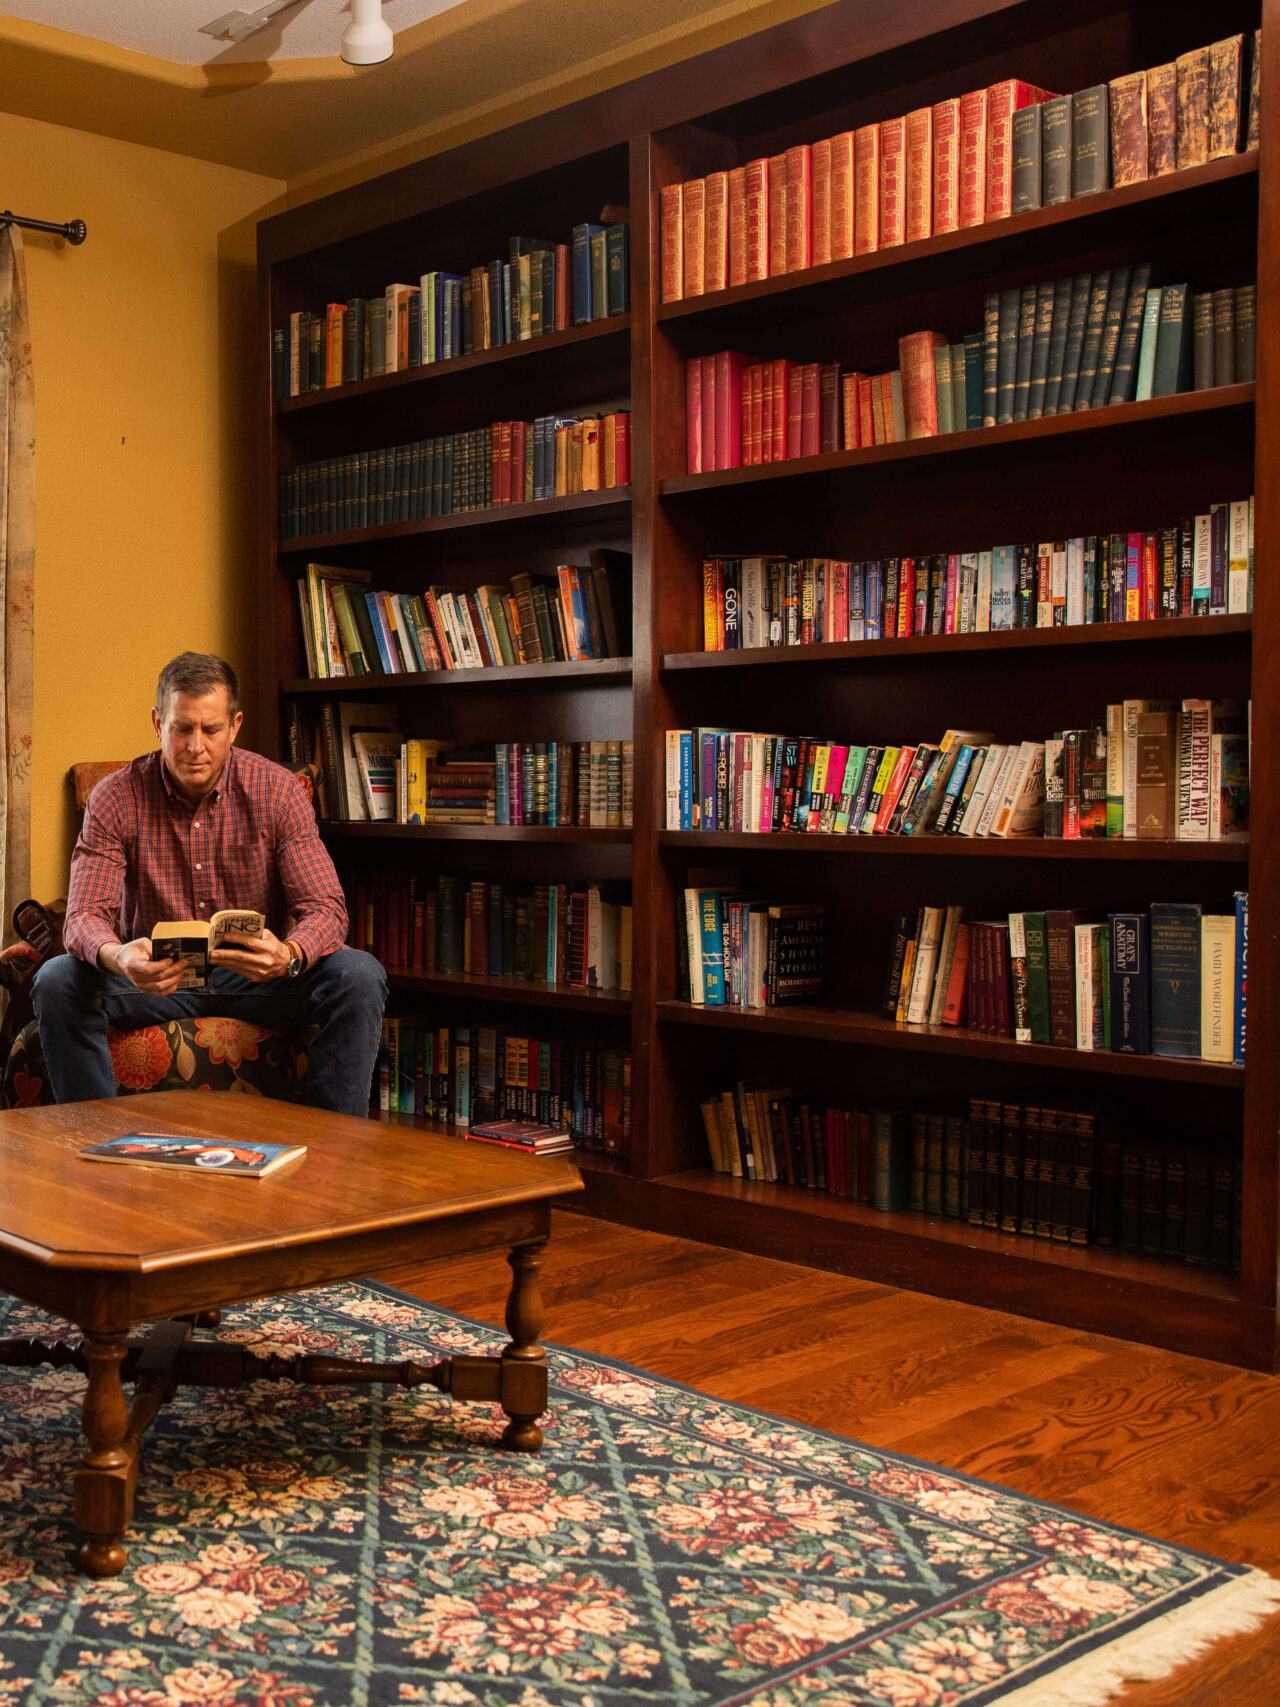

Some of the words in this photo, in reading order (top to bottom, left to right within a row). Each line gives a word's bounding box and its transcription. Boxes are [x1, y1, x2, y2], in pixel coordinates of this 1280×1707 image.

[1234, 517, 1246, 533] NORA
[1182, 531, 1192, 545] J.A.
[1198, 527, 1209, 557] SANDRA
[1233, 533, 1246, 556] ROBERTS
[1127, 546, 1139, 562] JANET
[1163, 540, 1176, 559] LINDA
[1182, 546, 1192, 569] JANCE
[1040, 557, 1048, 569] MARY
[1163, 559, 1176, 588] FAIRSTEIN
[1197, 559, 1208, 588] BROWN
[853, 575, 861, 591] VINCE
[948, 576, 956, 593] SUSAN
[802, 584, 813, 620] PATTERSON
[853, 592, 861, 608] FLYNN
[1040, 587, 1048, 602] CLARK
[1168, 588, 1176, 610] KILLER
[725, 588, 737, 631] GONE
[899, 588, 908, 632] DENIAL
[1127, 706, 1138, 720] KG
[1193, 709, 1209, 733] THE
[1127, 722, 1138, 738] 200
[1181, 709, 1193, 767] TECHNOWAR
[800, 740, 808, 765] STUART
[1109, 735, 1119, 769] LEAVING
[1180, 770, 1192, 780] IN
[1191, 736, 1211, 793] PERFECT
[717, 767, 727, 790] ROBB
[775, 765, 783, 789] WOODS
[797, 764, 805, 788] WOODS
[1047, 776, 1064, 787] Clan
[1109, 769, 1119, 794] HOME
[1047, 784, 1064, 795] Cave
[1047, 792, 1063, 800] Bear
[1083, 789, 1107, 801] WHISTLE
[1068, 805, 1079, 835] WHISTLER
[704, 898, 715, 913] THE
[214, 920, 261, 938] KING
[704, 913, 717, 933] EDGE
[722, 922, 730, 935] THE
[723, 935, 731, 968] 36-HOUR
[1116, 921, 1127, 970] ANATOMY
[1126, 929, 1136, 963] GRAY'S
[1015, 957, 1025, 978] Every
[1212, 942, 1222, 976] FAMILY
[723, 968, 732, 983] DAY
[1017, 978, 1028, 995] Day
[1016, 1003, 1027, 1029] Savior
